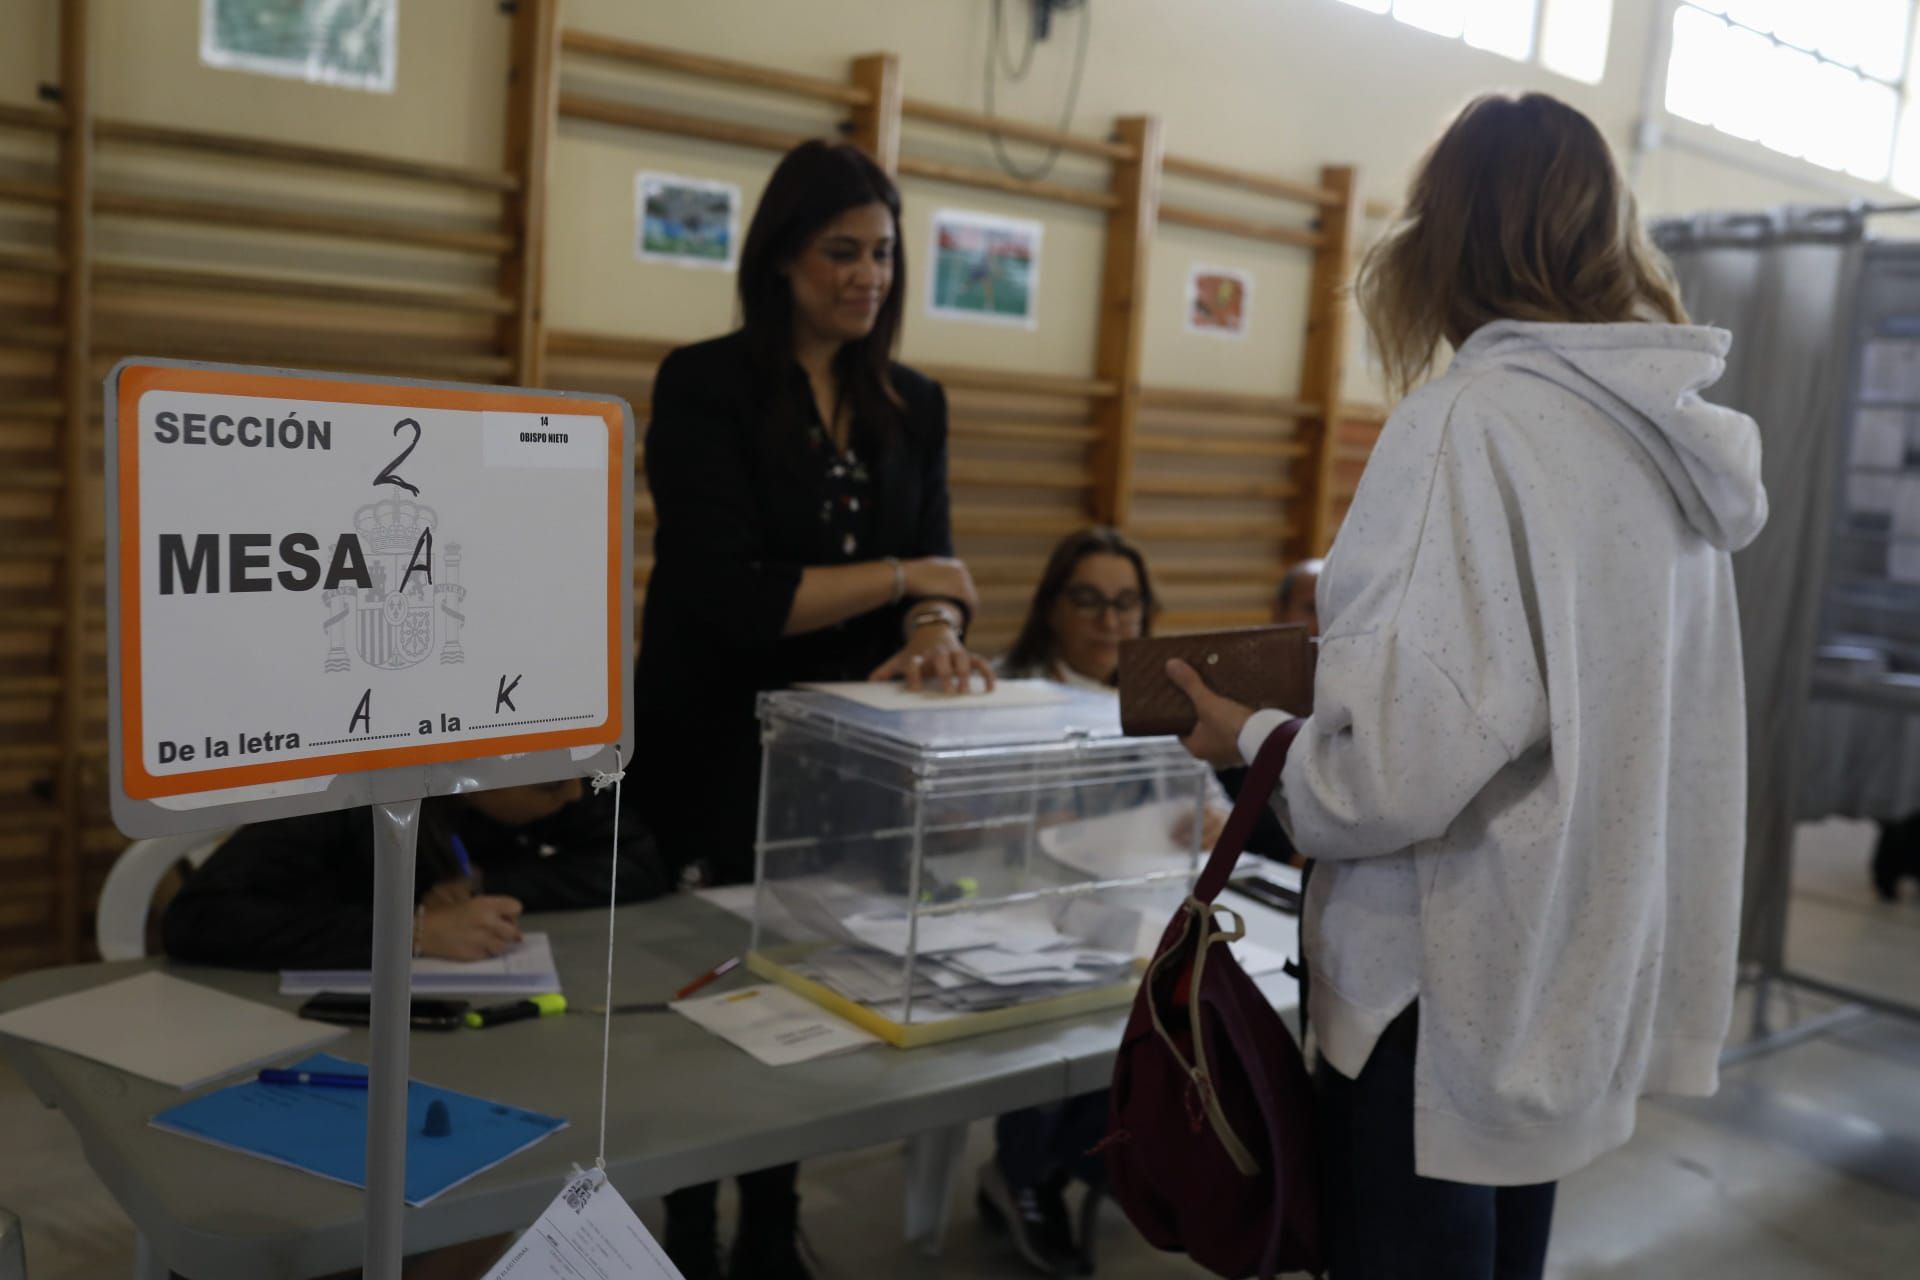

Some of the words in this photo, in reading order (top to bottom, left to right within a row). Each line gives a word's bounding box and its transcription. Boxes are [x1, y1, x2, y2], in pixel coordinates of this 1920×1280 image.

[156, 411, 331, 450] SECCIÓN
[519, 432, 547, 443] OBISPO
[548, 433, 569, 444] NIETO
[540, 416, 549, 427] 14
[372, 417, 421, 497] 2
[158, 532, 373, 595] MESA
[400, 526, 433, 593] A
[348, 688, 372, 734] A
[495, 674, 522, 714] K
[418, 719, 433, 735] a
[440, 713, 461, 733] la
[158, 740, 195, 764] De
[205, 736, 229, 758] la
[238, 731, 301, 754] letra
